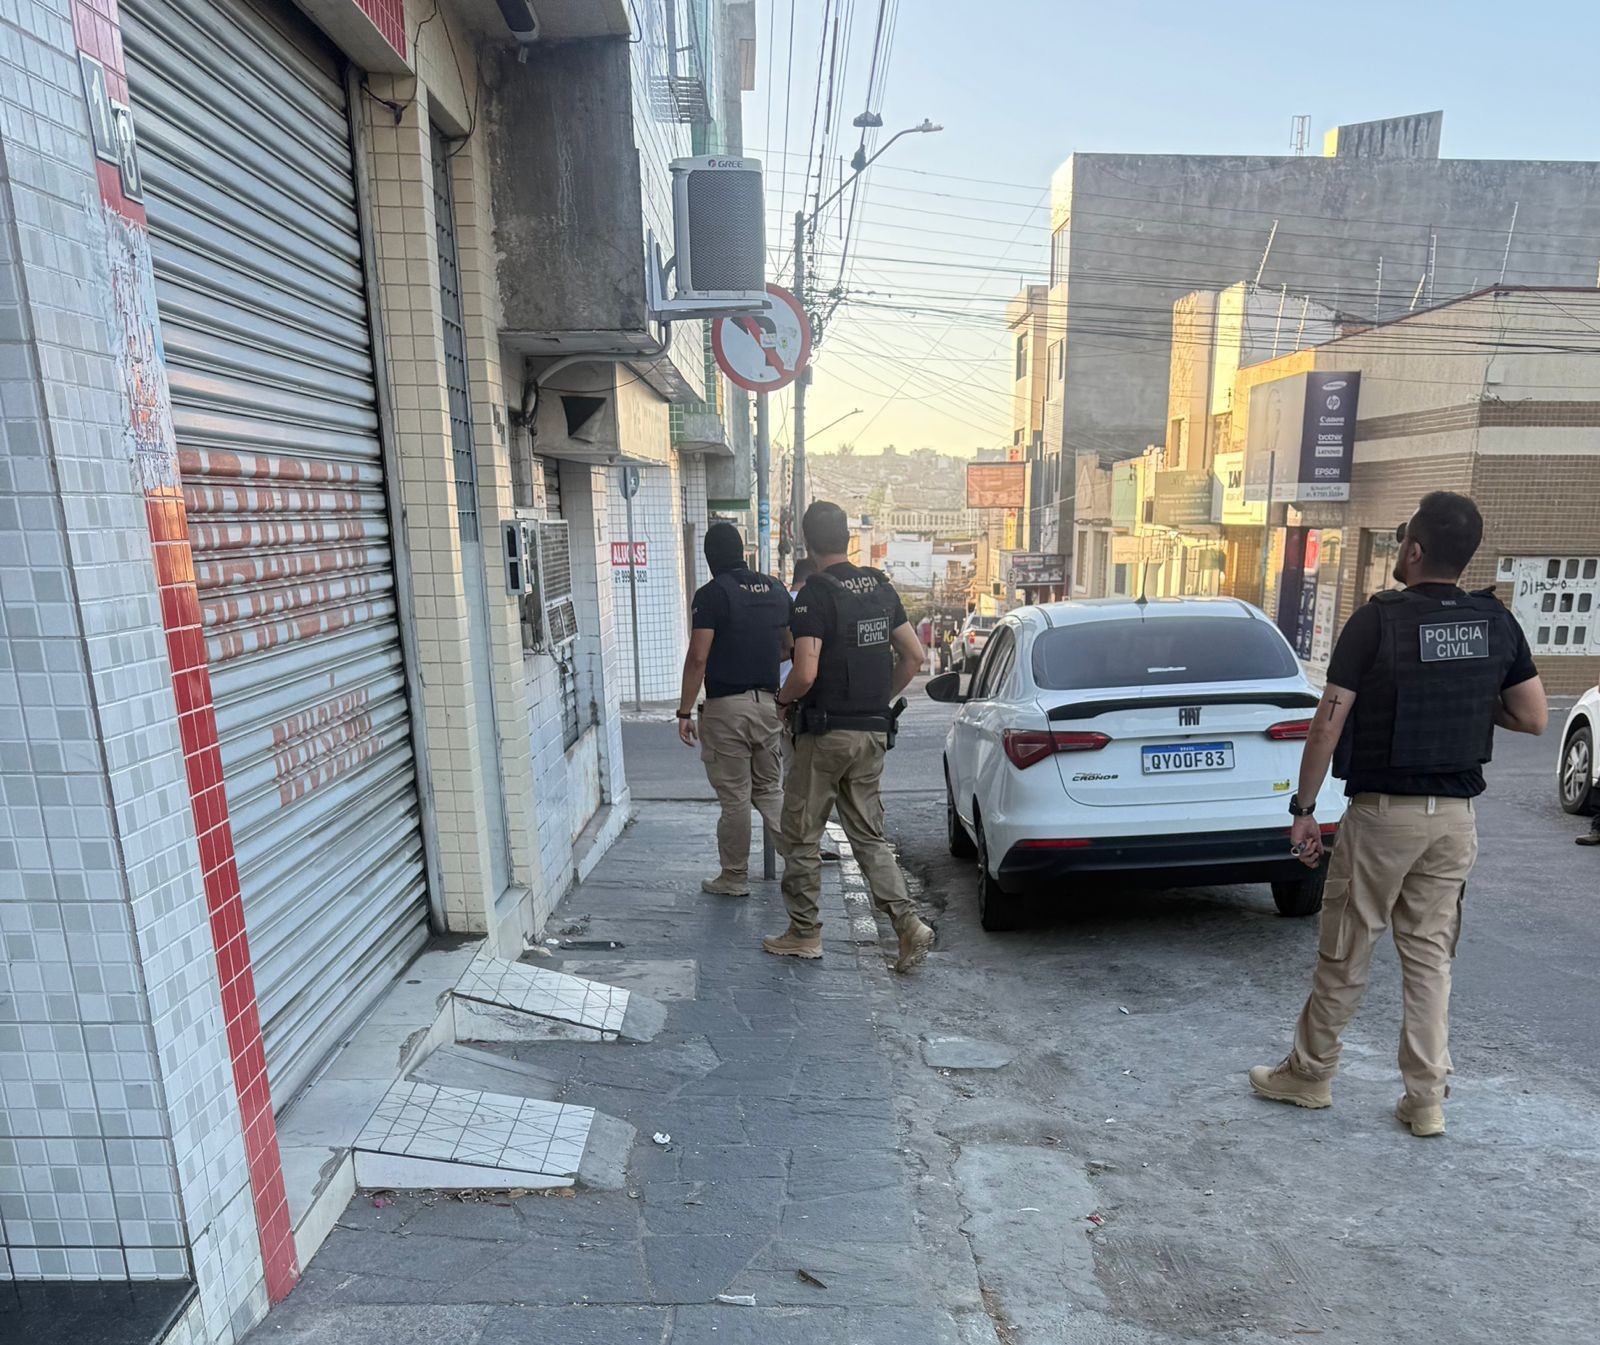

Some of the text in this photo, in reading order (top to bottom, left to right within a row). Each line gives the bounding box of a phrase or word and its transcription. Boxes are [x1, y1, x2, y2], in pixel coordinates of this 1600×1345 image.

[717, 160, 743, 169] GREE
[1315, 468, 1340, 476] EPSON
[864, 631, 885, 643] CIVIL
[1425, 624, 1483, 644] POLÍCIA
[1436, 642, 1474, 658] CIVIL
[1179, 706, 1202, 726] FIAT
[1072, 774, 1119, 782] CRONOS
